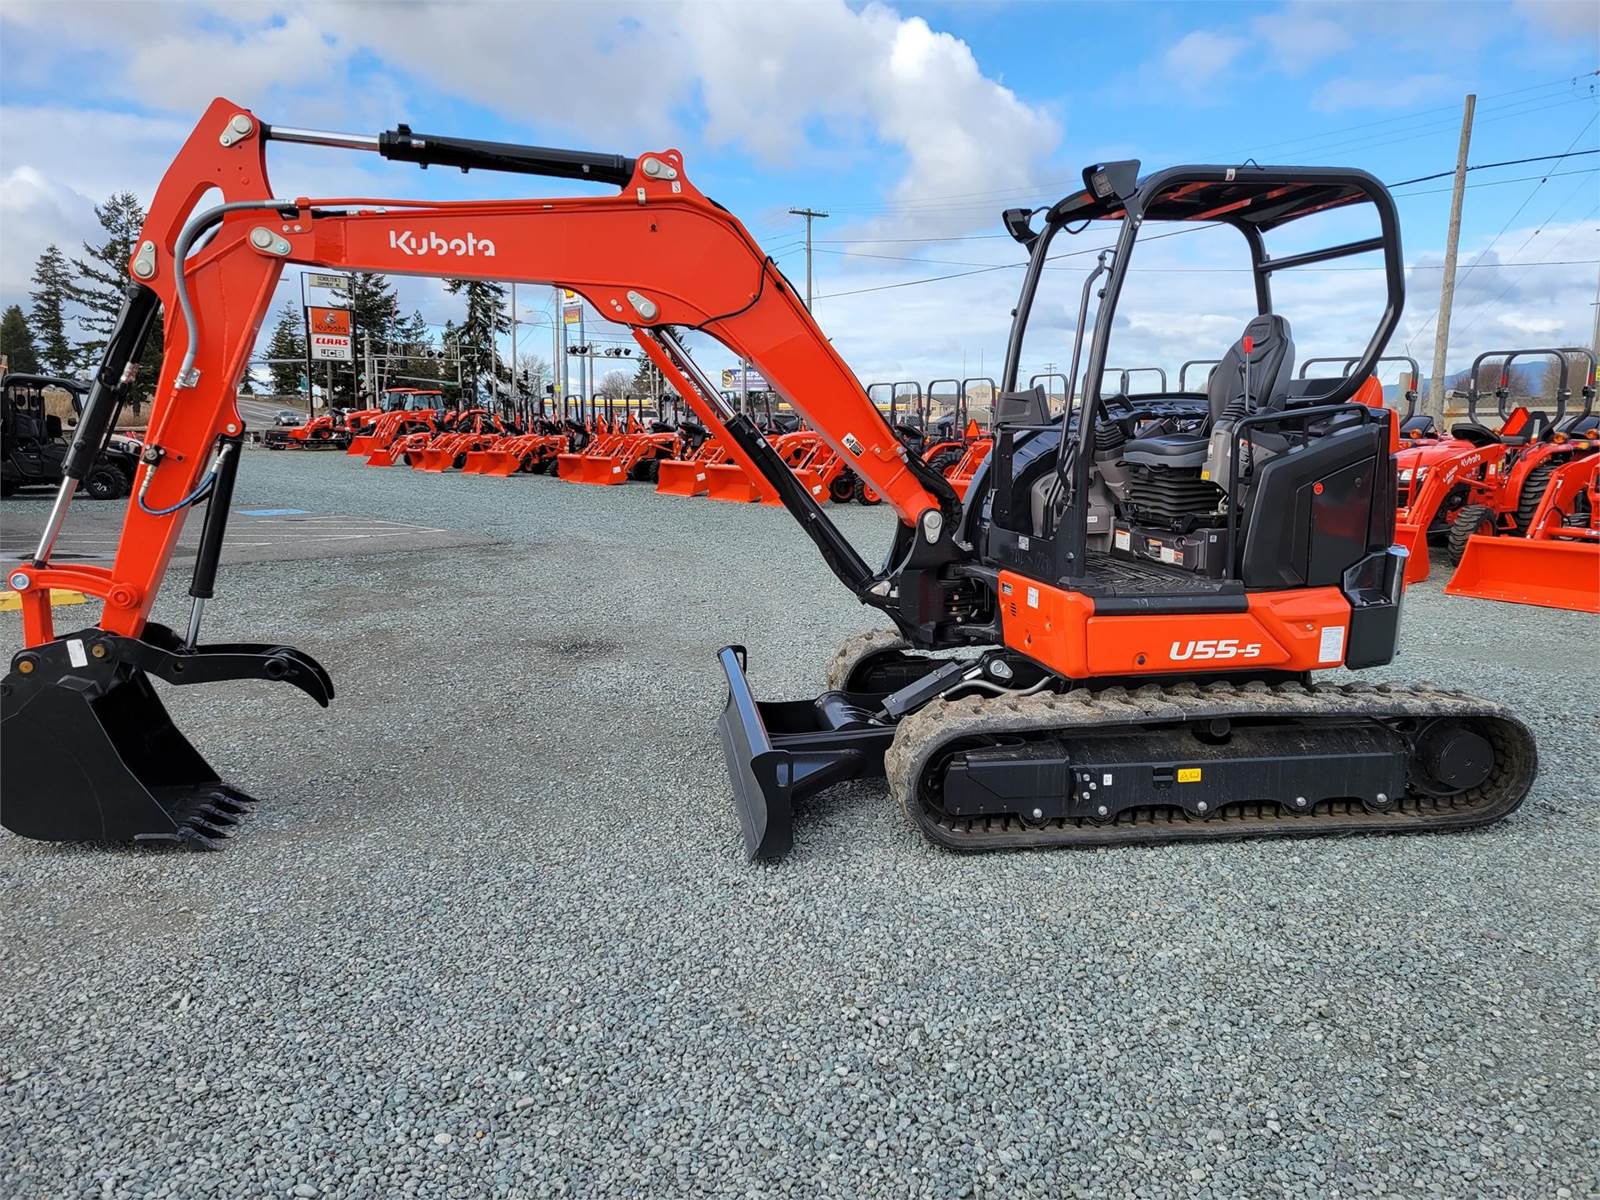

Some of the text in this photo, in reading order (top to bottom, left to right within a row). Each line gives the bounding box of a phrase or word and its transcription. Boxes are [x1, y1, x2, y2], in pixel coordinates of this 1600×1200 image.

[389, 230, 495, 256] Kubota
[315, 322, 347, 332] Kubota
[316, 337, 348, 345] CLAAS
[321, 348, 344, 357] JCB
[1169, 639, 1262, 660] U55-5
